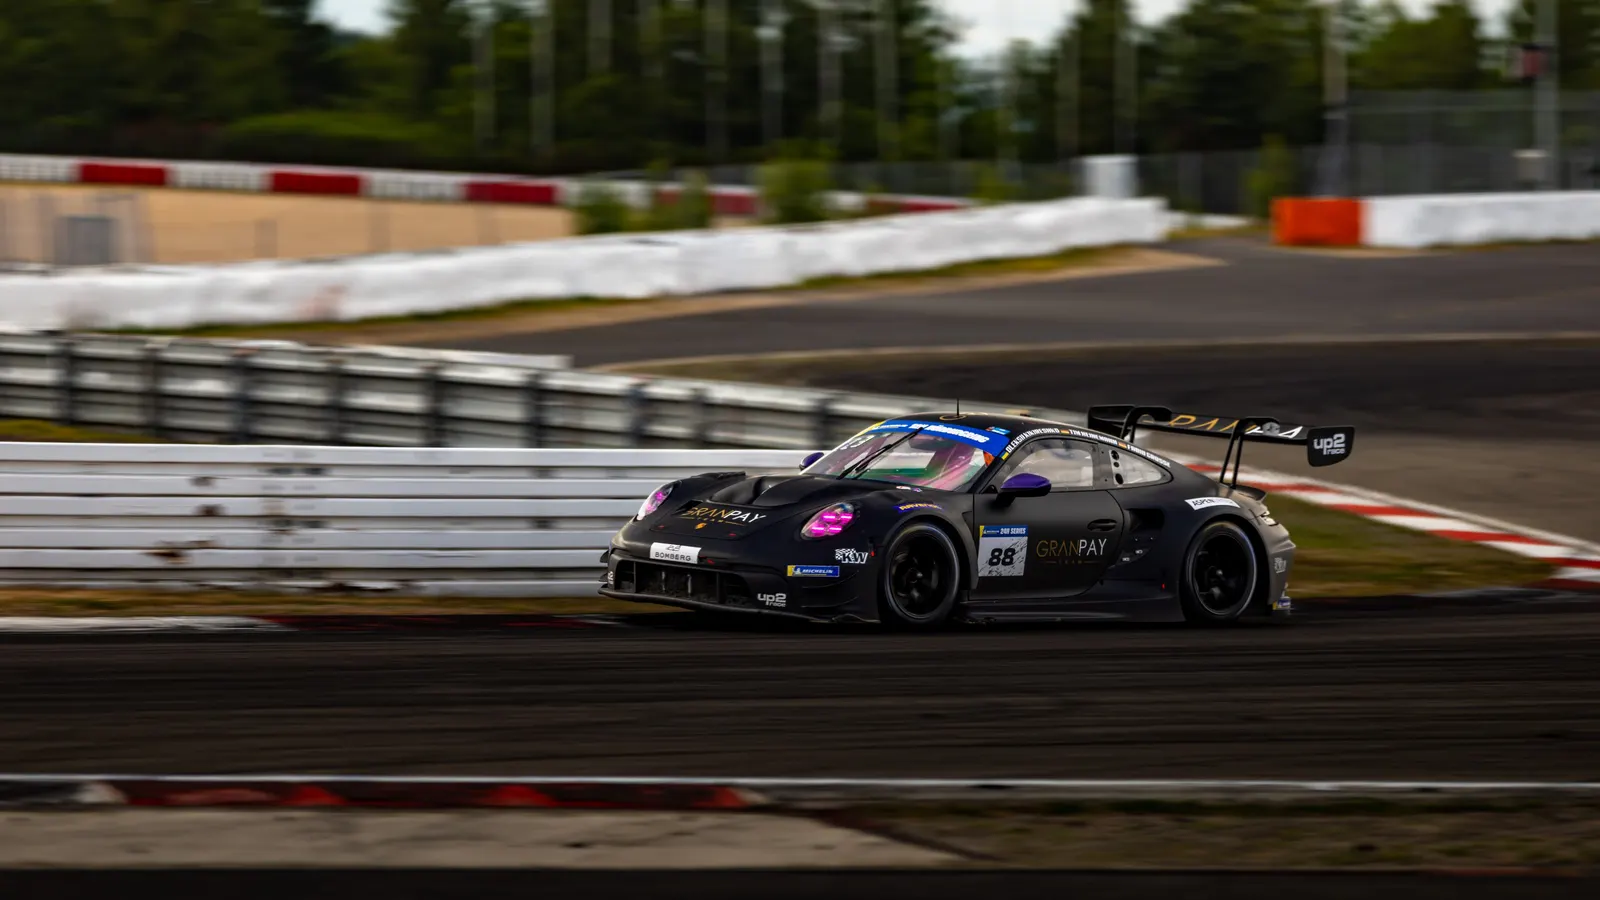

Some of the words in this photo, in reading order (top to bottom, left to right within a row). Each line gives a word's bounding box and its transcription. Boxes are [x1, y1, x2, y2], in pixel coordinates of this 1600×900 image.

[1313, 433, 1346, 455] up2
[1010, 527, 1026, 535] SERIES
[1036, 538, 1107, 558] GRANPAY
[655, 551, 692, 562] BOMBERG
[841, 552, 868, 564] KW
[988, 548, 1016, 567] 88
[757, 593, 787, 605] up2
